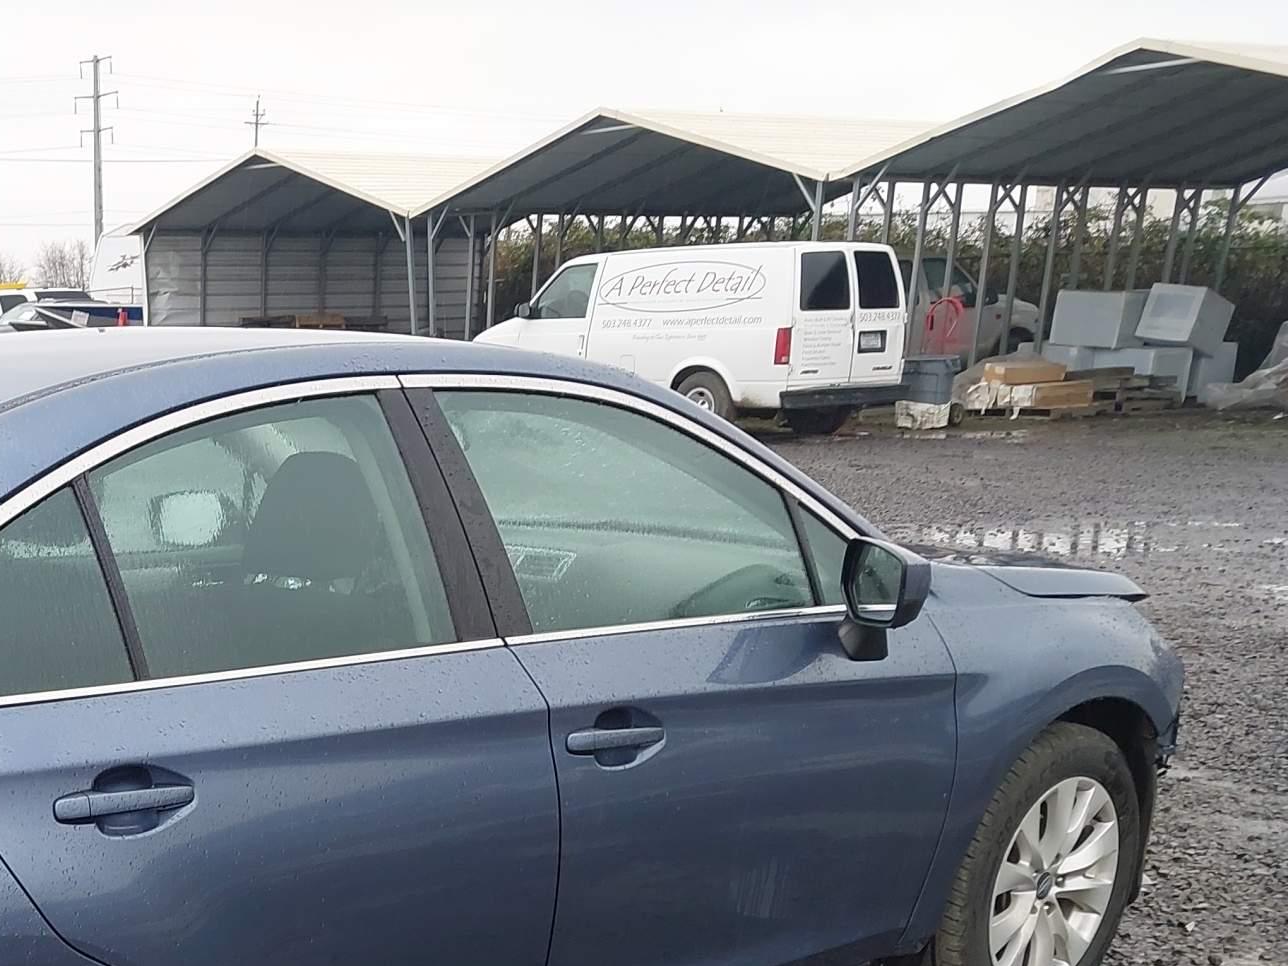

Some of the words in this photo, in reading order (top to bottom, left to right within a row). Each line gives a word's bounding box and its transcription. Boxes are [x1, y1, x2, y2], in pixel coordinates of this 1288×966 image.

[604, 276, 625, 298] A
[627, 267, 695, 297] Perfect
[696, 264, 764, 295] Detail
[662, 315, 763, 328] www.aperfectdetail.com
